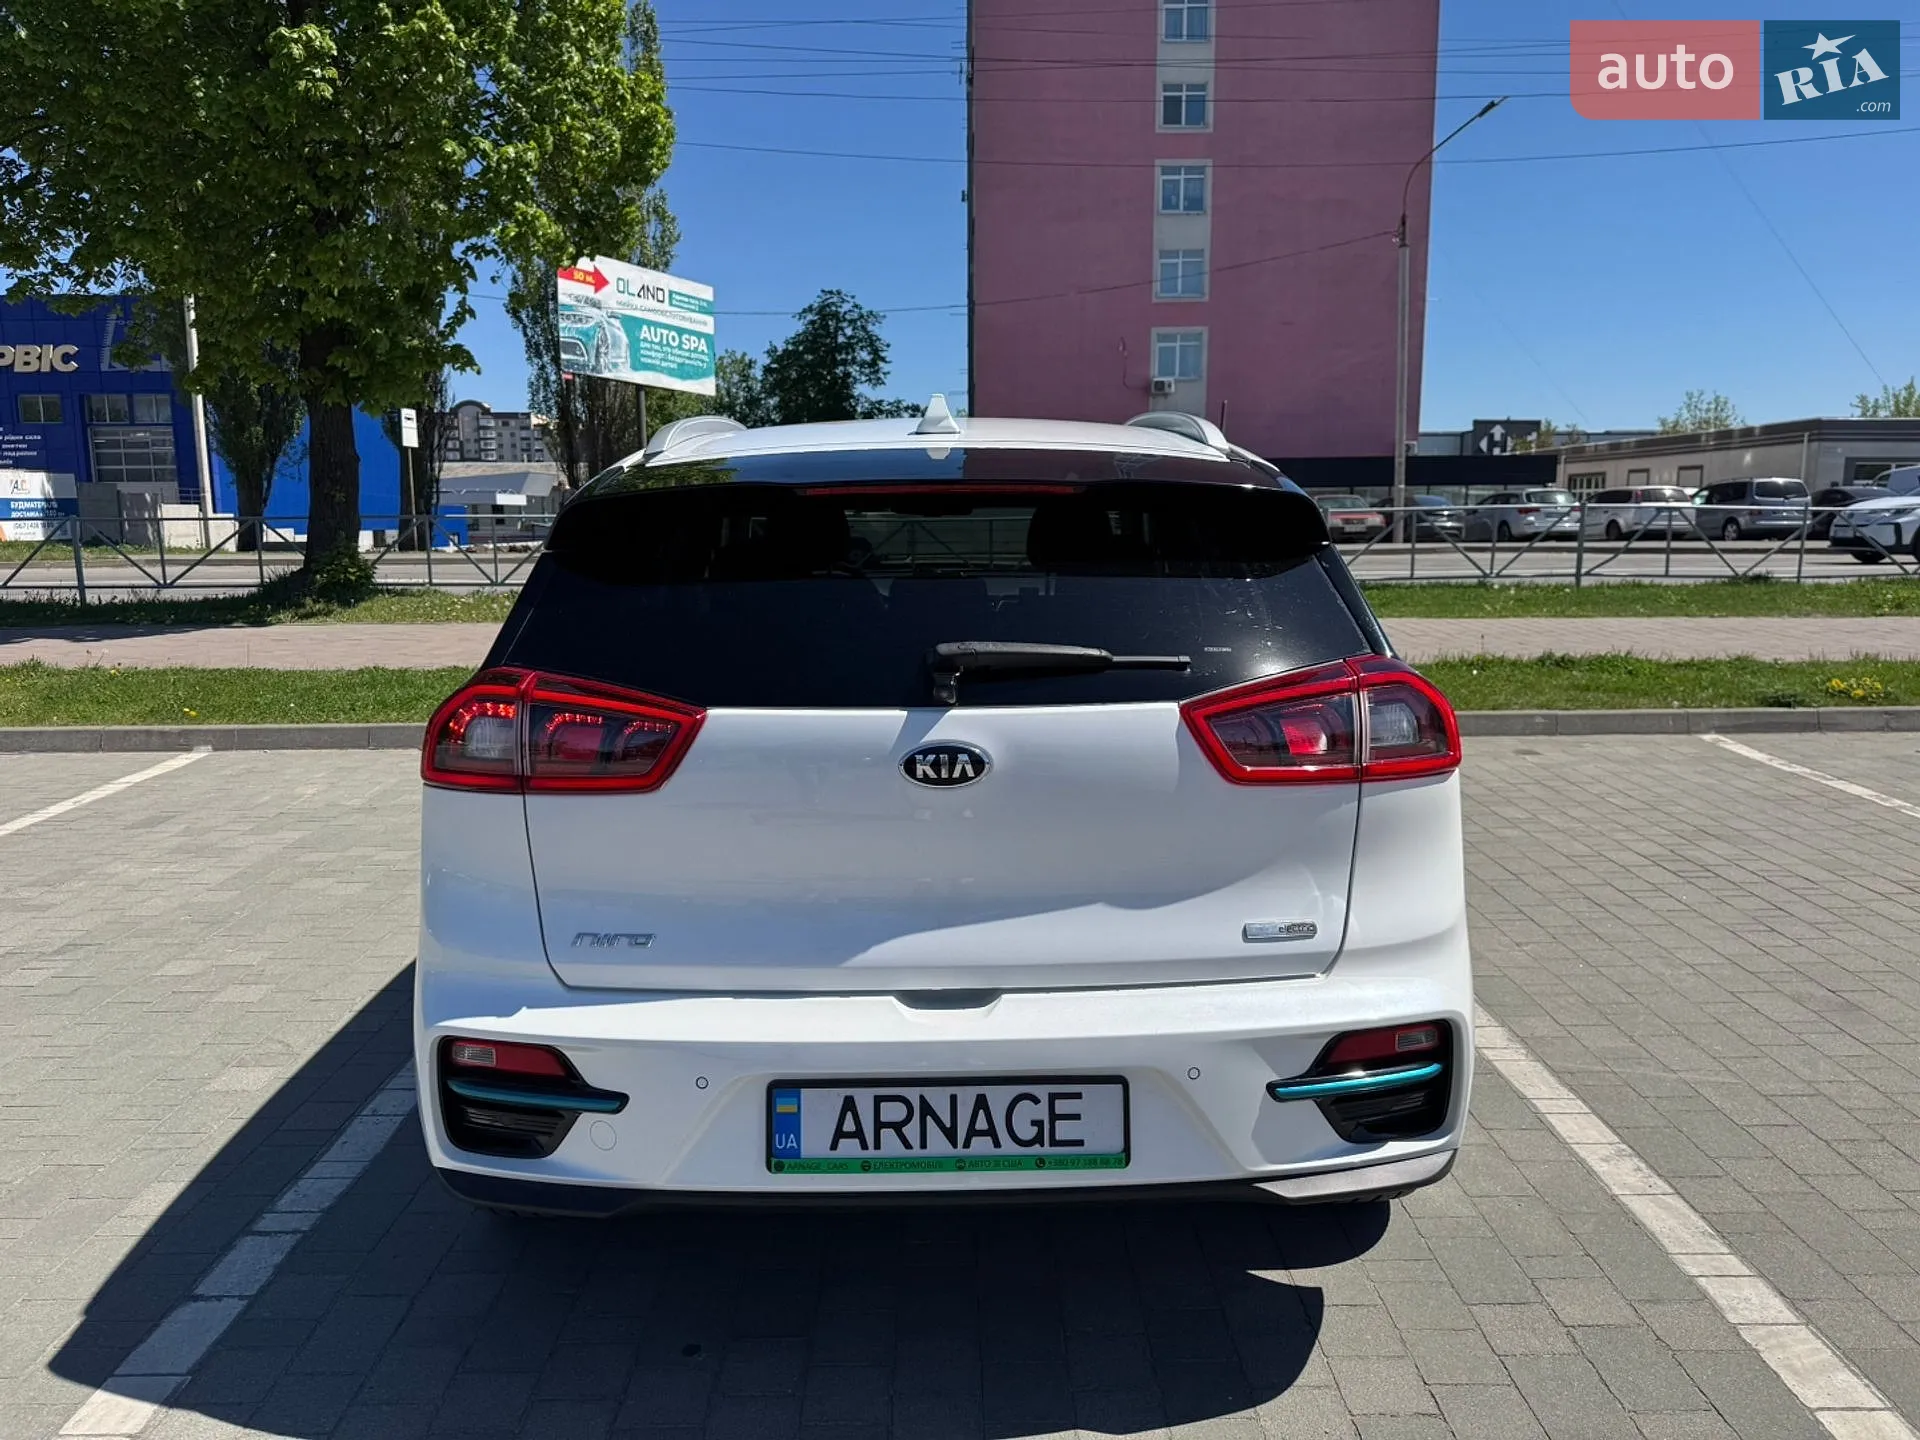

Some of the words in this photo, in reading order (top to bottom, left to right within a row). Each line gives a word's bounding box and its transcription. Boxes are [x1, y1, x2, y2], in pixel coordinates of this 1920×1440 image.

[616, 277, 665, 303] OLAND
[640, 324, 679, 347] AUTO
[681, 334, 708, 353] SPA
[914, 754, 975, 780] KIA
[829, 1092, 1085, 1151] ARNAGE
[775, 1133, 798, 1149] UA
